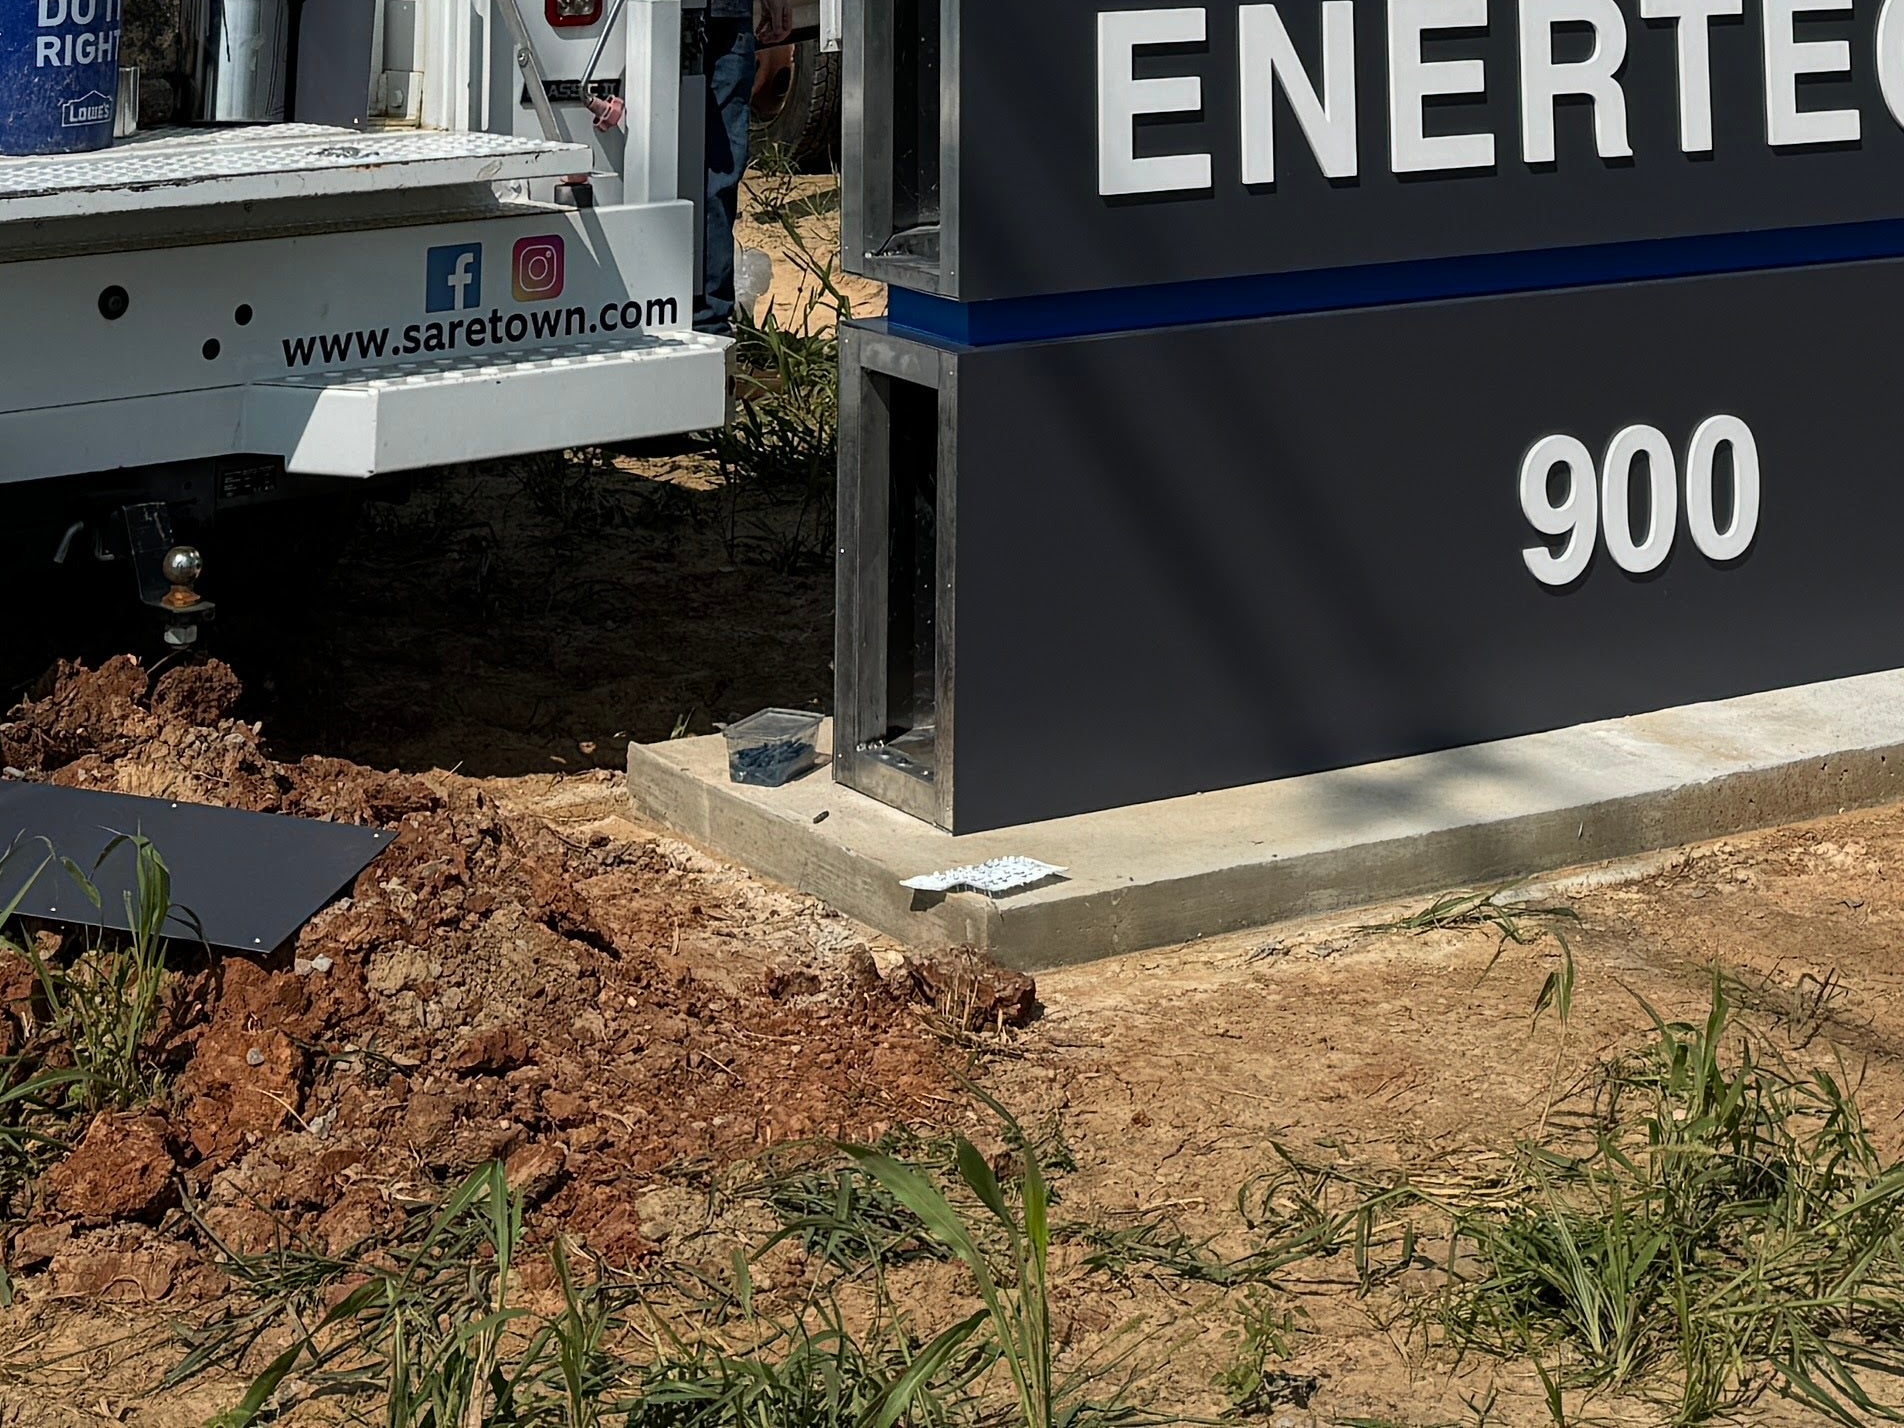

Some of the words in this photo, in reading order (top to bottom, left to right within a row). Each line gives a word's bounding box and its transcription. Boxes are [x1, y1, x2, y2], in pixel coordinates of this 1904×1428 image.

[36, 30, 120, 68] RIGHT
[282, 297, 678, 368] www.saretown.com
[1519, 414, 1761, 588] 900
